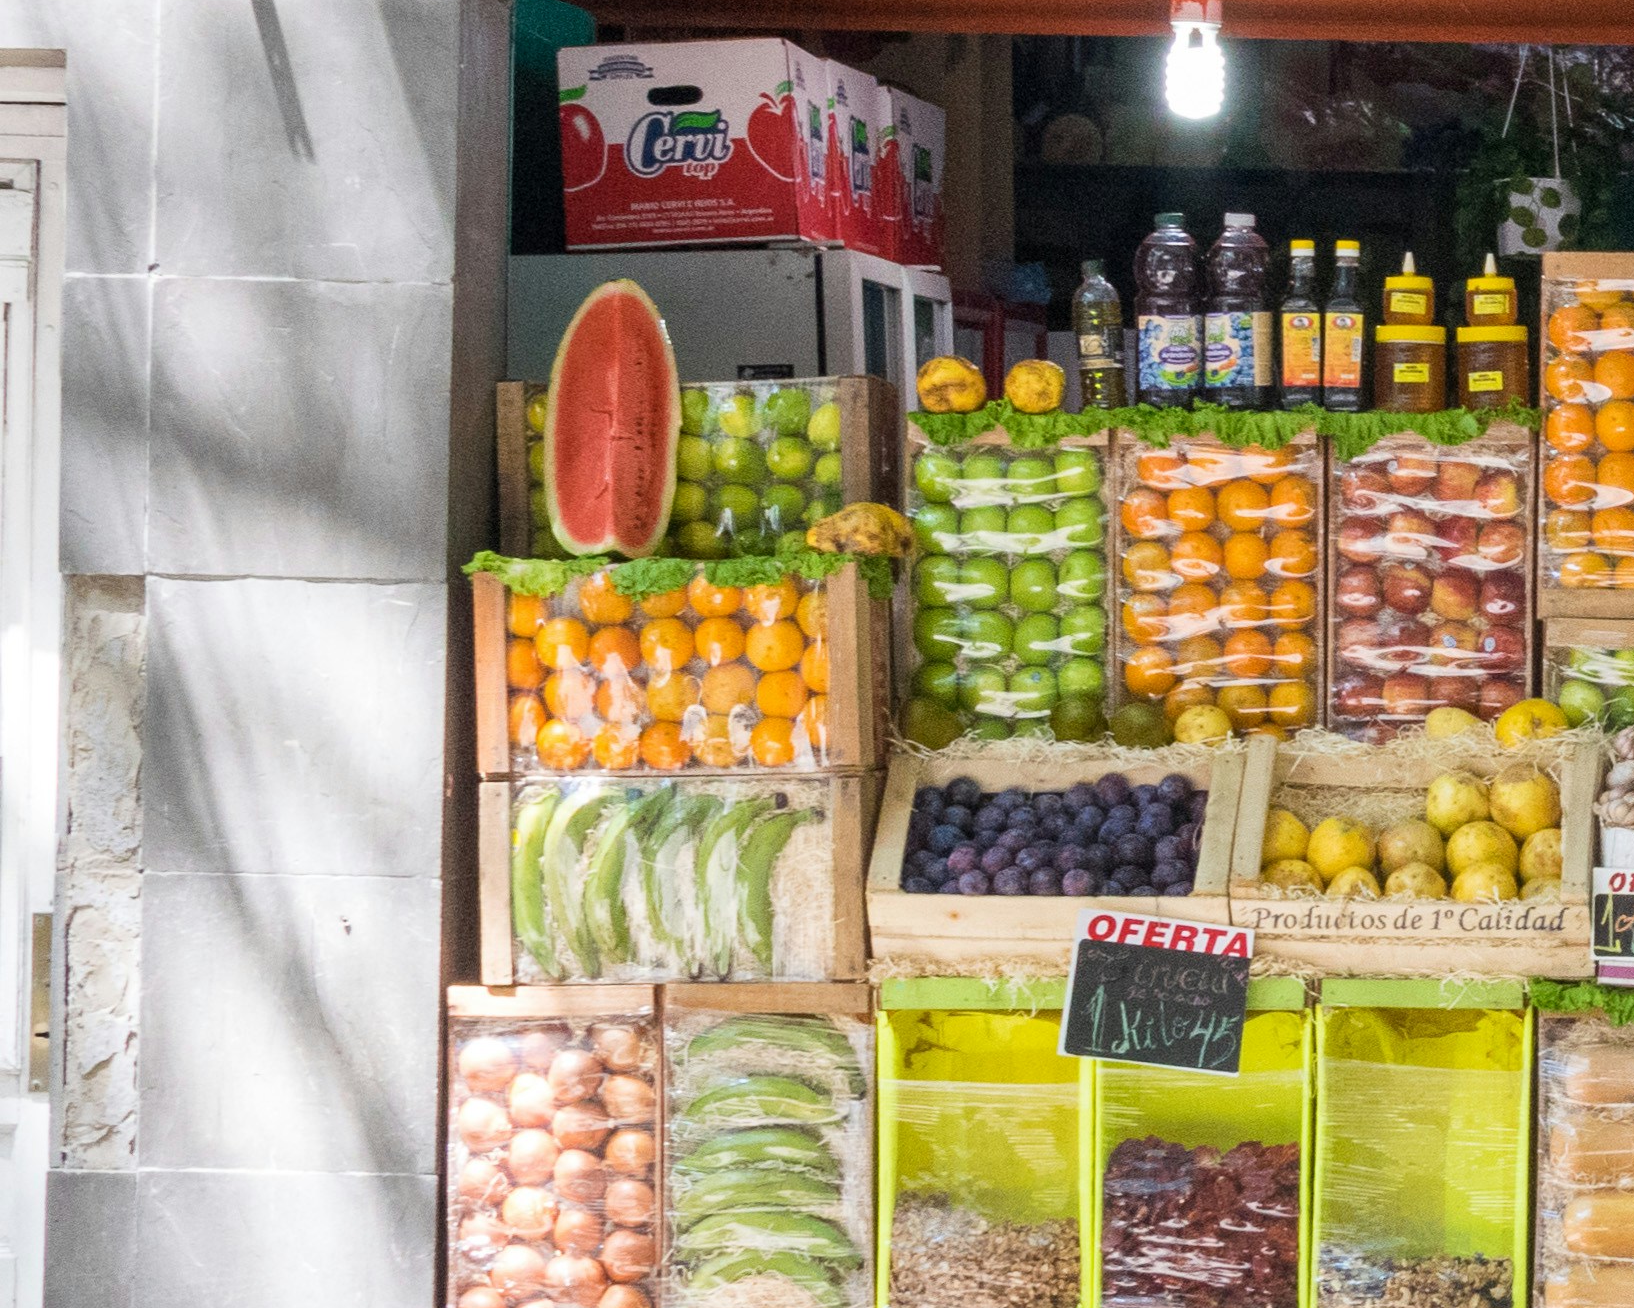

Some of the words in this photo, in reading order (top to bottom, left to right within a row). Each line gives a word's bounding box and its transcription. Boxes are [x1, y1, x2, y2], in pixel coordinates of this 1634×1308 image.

[625, 110, 733, 177] Cervi
[683, 162, 719, 180] top
[1087, 914, 1249, 958] OFERTA
[1252, 905, 1387, 930] Productos
[1393, 905, 1422, 930] de
[1458, 905, 1570, 932] Calidad
[1189, 1010, 1240, 1068] 45
